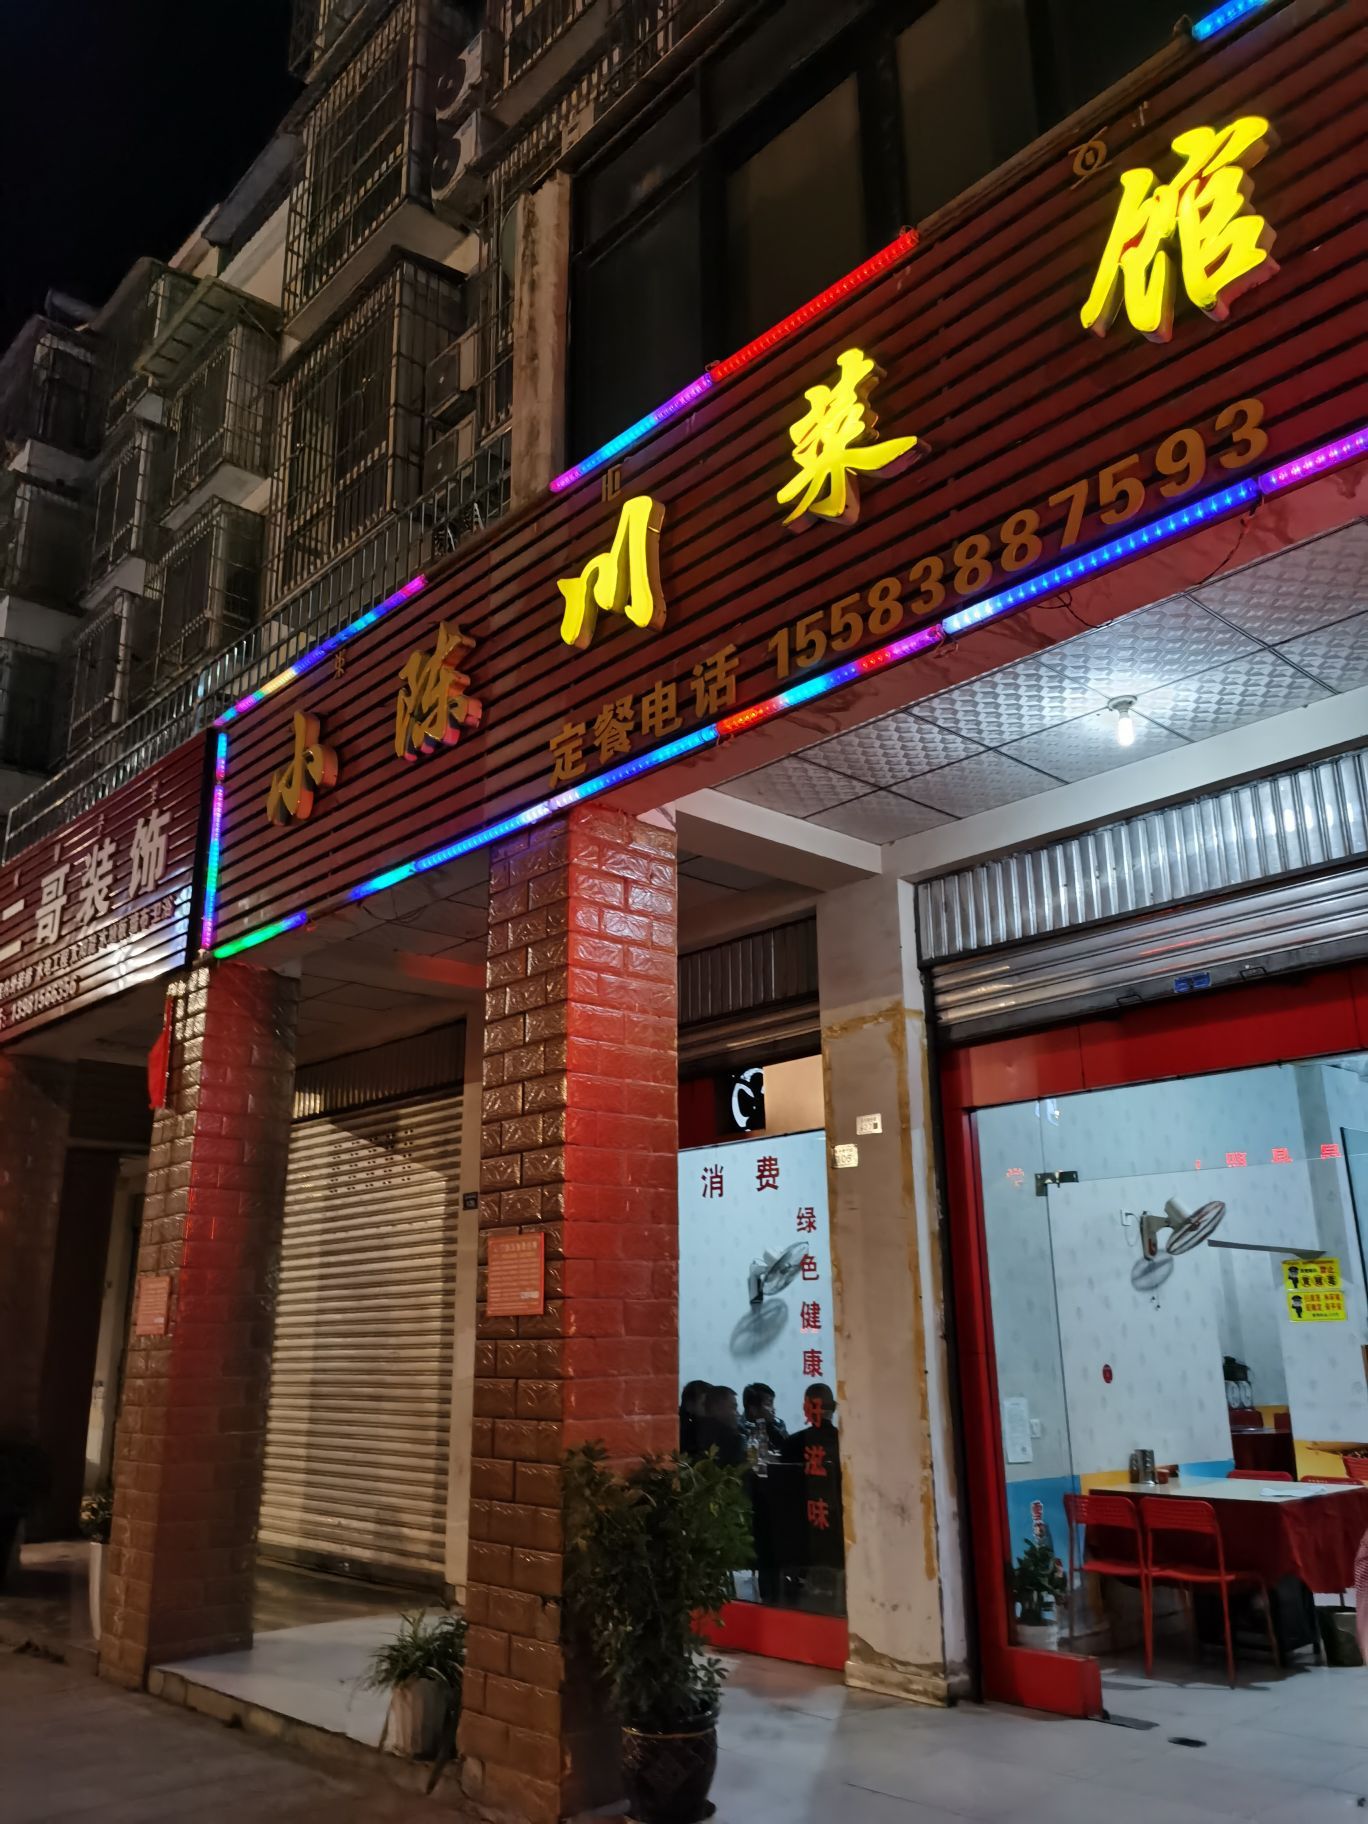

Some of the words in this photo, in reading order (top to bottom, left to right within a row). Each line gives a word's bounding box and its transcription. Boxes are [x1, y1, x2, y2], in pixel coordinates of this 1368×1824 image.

[549, 643, 740, 788] 定餐电话
[768, 398, 1269, 680] 15583887593
[701, 1156, 780, 1199] 消费
